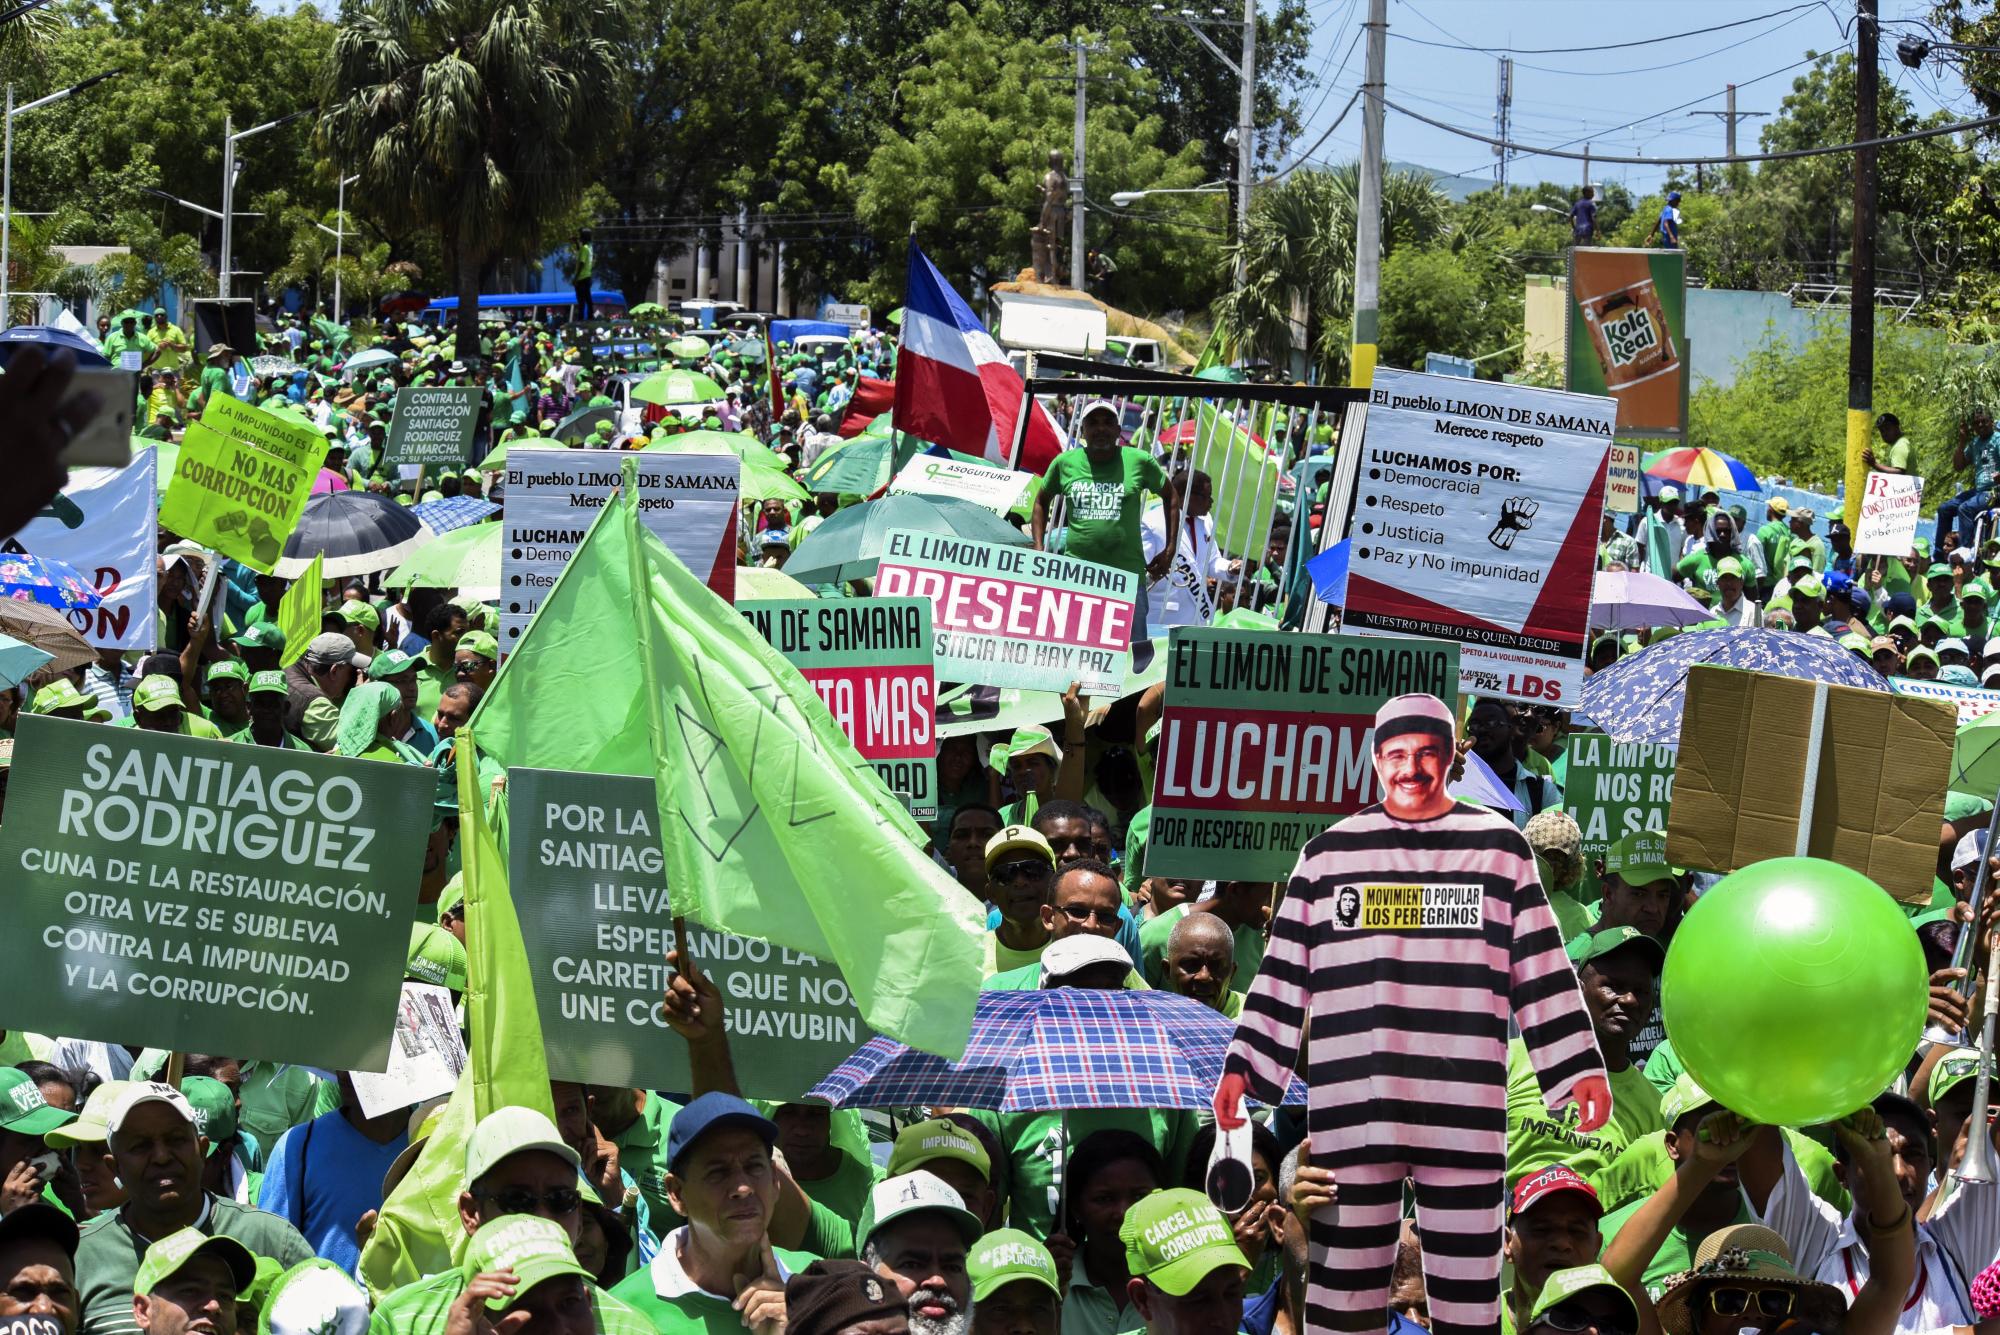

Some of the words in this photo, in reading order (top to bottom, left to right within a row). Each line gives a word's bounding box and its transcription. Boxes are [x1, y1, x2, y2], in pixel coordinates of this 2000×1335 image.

[1603, 311, 1649, 344] Kola
[1610, 326, 1655, 364] Real
[403, 405, 471, 417] CORRUPCION
[411, 393, 453, 404] CONTRA
[455, 393, 467, 404] LA
[409, 418, 460, 430] SANTIAGO
[1373, 390, 1389, 405] El
[1392, 394, 1441, 412] pueblo
[1444, 399, 1504, 422] LIMON
[1508, 409, 1532, 424] DE
[1535, 412, 1612, 436] SAMANA
[219, 404, 232, 418] LA
[233, 410, 293, 444] IMPUNIDAD
[294, 438, 307, 451] ES
[307, 443, 320, 457] LA
[404, 431, 462, 442] RODRIGUEZ
[1434, 420, 1489, 440] Merece
[1492, 430, 1544, 448] respeto
[230, 427, 270, 451] MADRE
[271, 444, 284, 457] DE
[284, 449, 297, 463] LA
[385, 455, 406, 463] POR
[408, 455, 420, 463] SU
[422, 455, 466, 463] HOSPITAL
[400, 444, 414, 455] EN
[416, 443, 460, 455] MARCHA
[1627, 450, 1635, 464] A
[231, 450, 258, 477] NO
[258, 461, 298, 495] MAS
[947, 464, 1011, 482] ASOGUITURD
[1371, 449, 1472, 475] LUCHAMOS
[1477, 463, 1521, 483] POR:
[181, 457, 292, 521] CORRUPCION
[508, 471, 523, 485] El
[527, 471, 574, 489] pueblo
[639, 475, 660, 488] DE
[664, 475, 738, 490] SAMANA
[1071, 481, 1124, 493] #MARCHA
[1384, 468, 1481, 496] Democracia
[1611, 483, 1637, 495] VERDE
[569, 493, 606, 507] Mere
[638, 498, 674, 512] speto
[1070, 492, 1124, 510] VERDE
[1381, 495, 1445, 517] Respeto
[1862, 491, 1922, 519] CONSTITUYENTE
[512, 529, 585, 544] LUCHAM
[1378, 522, 1444, 545] Justicia
[889, 533, 911, 557] EL
[920, 536, 991, 569] LIMON
[997, 549, 1027, 574] DE
[1031, 555, 1127, 594] SAMANA
[1374, 547, 1403, 564] Paz
[1407, 555, 1417, 569] y
[1422, 554, 1445, 570] No
[1450, 557, 1540, 583] impunidad
[878, 566, 1130, 648] PRESENTE
[66, 605, 130, 640] ON
[781, 608, 811, 652] DE
[818, 606, 921, 651] SAMANA
[1366, 613, 1418, 631] NUESTRO
[1420, 622, 1464, 637] PUEBLO
[1466, 627, 1479, 639] ES
[1481, 630, 1518, 646] QUIEN
[1519, 637, 1561, 652] DECIDE
[934, 632, 996, 661] STICIA
[1001, 640, 1028, 664] NO
[1035, 645, 1075, 669] HAY
[1079, 652, 1113, 674] PAZ
[1461, 647, 1483, 657] SPETO
[1489, 651, 1498, 660] LA
[1499, 653, 1534, 665] VOLUNTAD
[1535, 659, 1567, 670] POPULAR
[1174, 639, 1201, 689] EL
[1210, 641, 1291, 693] LIMON
[1298, 645, 1335, 695] DE
[1339, 648, 1448, 699] SAMANA
[1465, 668, 1498, 680] JUSTICIA
[1475, 677, 1502, 691] PAZ
[1506, 674, 1562, 702] LDS
[864, 676, 930, 747] MAS
[1162, 719, 1385, 804] LUCHAM
[1572, 738, 1600, 767] LA
[82, 743, 363, 822] SANTIAGO
[1595, 773, 1642, 802] NOS
[58, 788, 376, 873] RODRIGUEZ
[546, 803, 605, 834] POR
[615, 807, 651, 837] LA
[1006, 828, 1019, 841] P
[1153, 817, 1188, 848] POR
[1191, 819, 1264, 851] RESPERO
[1269, 820, 1301, 852] PAZ
[1579, 843, 1612, 853] ARCH
[1655, 840, 1665, 850] SU
[540, 838, 664, 874] SANTIAG
[1629, 854, 1641, 865] EN
[20, 847, 97, 880] CUNA
[105, 858, 141, 885] DE
[149, 864, 181, 891] LA
[189, 869, 392, 920] RESTAURACIÓN,
[1366, 887, 1432, 906] MOVIMIENTO
[1434, 887, 1480, 906] POPULAR
[64, 890, 135, 922] OTRA
[142, 899, 187, 928] VEZ
[195, 906, 224, 932] SE
[232, 911, 340, 946] SUBLEVA
[1366, 908, 1390, 925] LOS
[1394, 907, 1479, 925] PEREGRINOS
[42, 925, 154, 961] CONTRA
[162, 938, 194, 966] LA
[201, 944, 350, 984] IMPUNIDAD
[415, 955, 427, 967] FIN
[428, 960, 438, 969] DE
[782, 945, 818, 967] LA
[409, 963, 444, 983] IMPUNIDAD
[727, 971, 788, 1002] QUE
[65, 963, 81, 987] Y
[87, 965, 119, 993] LA
[126, 972, 315, 1017] CORRUPCIÓN.
[560, 992, 615, 1023] UNE
[626, 999, 670, 1028] CO
[16, 1088, 47, 1112] VER
[922, 1135, 976, 1154] IMPUNIDAD
[1193, 1208, 1203, 1223] A
